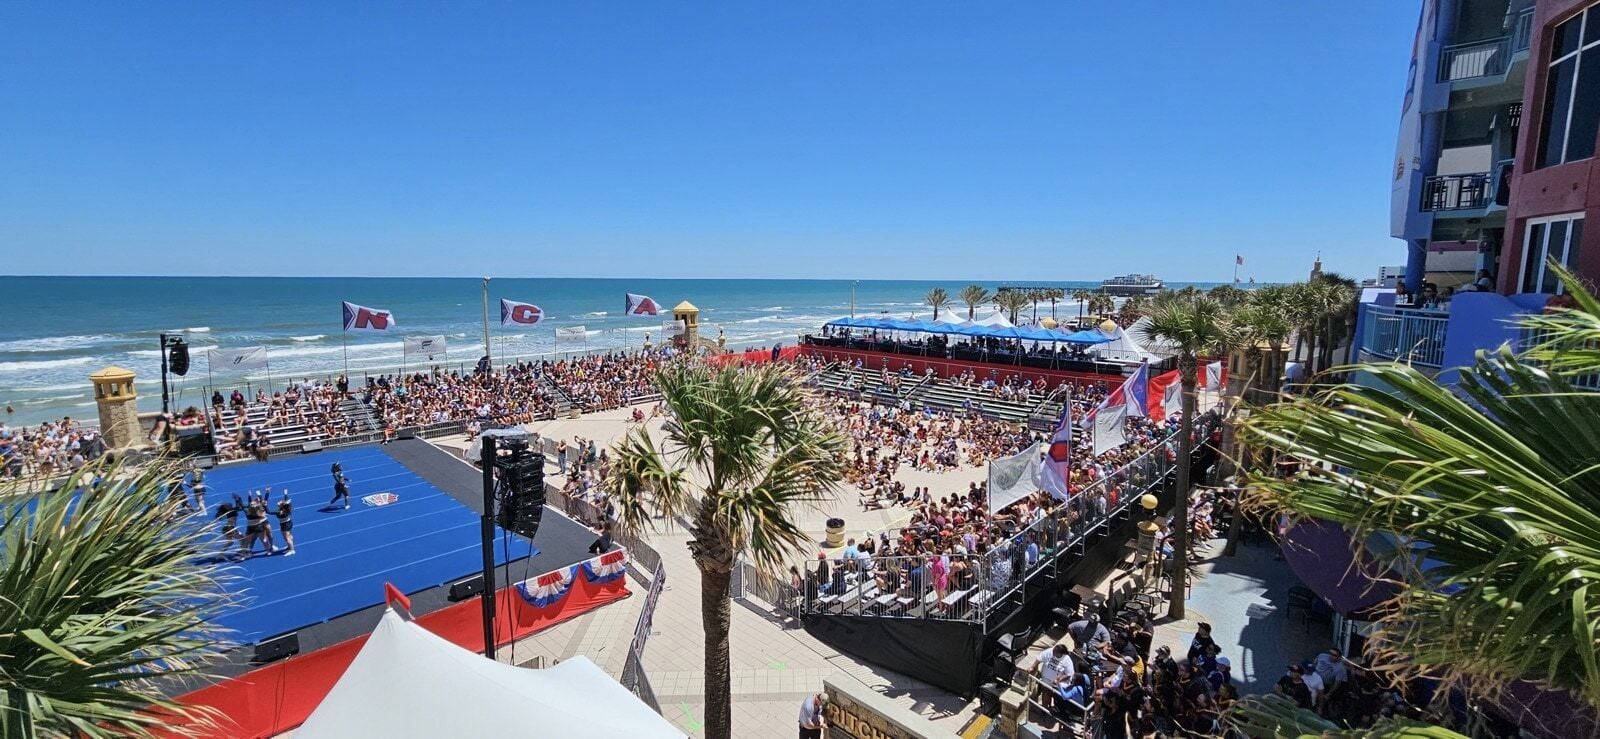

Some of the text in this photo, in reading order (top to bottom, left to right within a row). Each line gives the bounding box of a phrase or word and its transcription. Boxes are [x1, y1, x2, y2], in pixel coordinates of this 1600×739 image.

[512, 305, 541, 324] C
[633, 298, 657, 315] A
[354, 307, 390, 329] N
